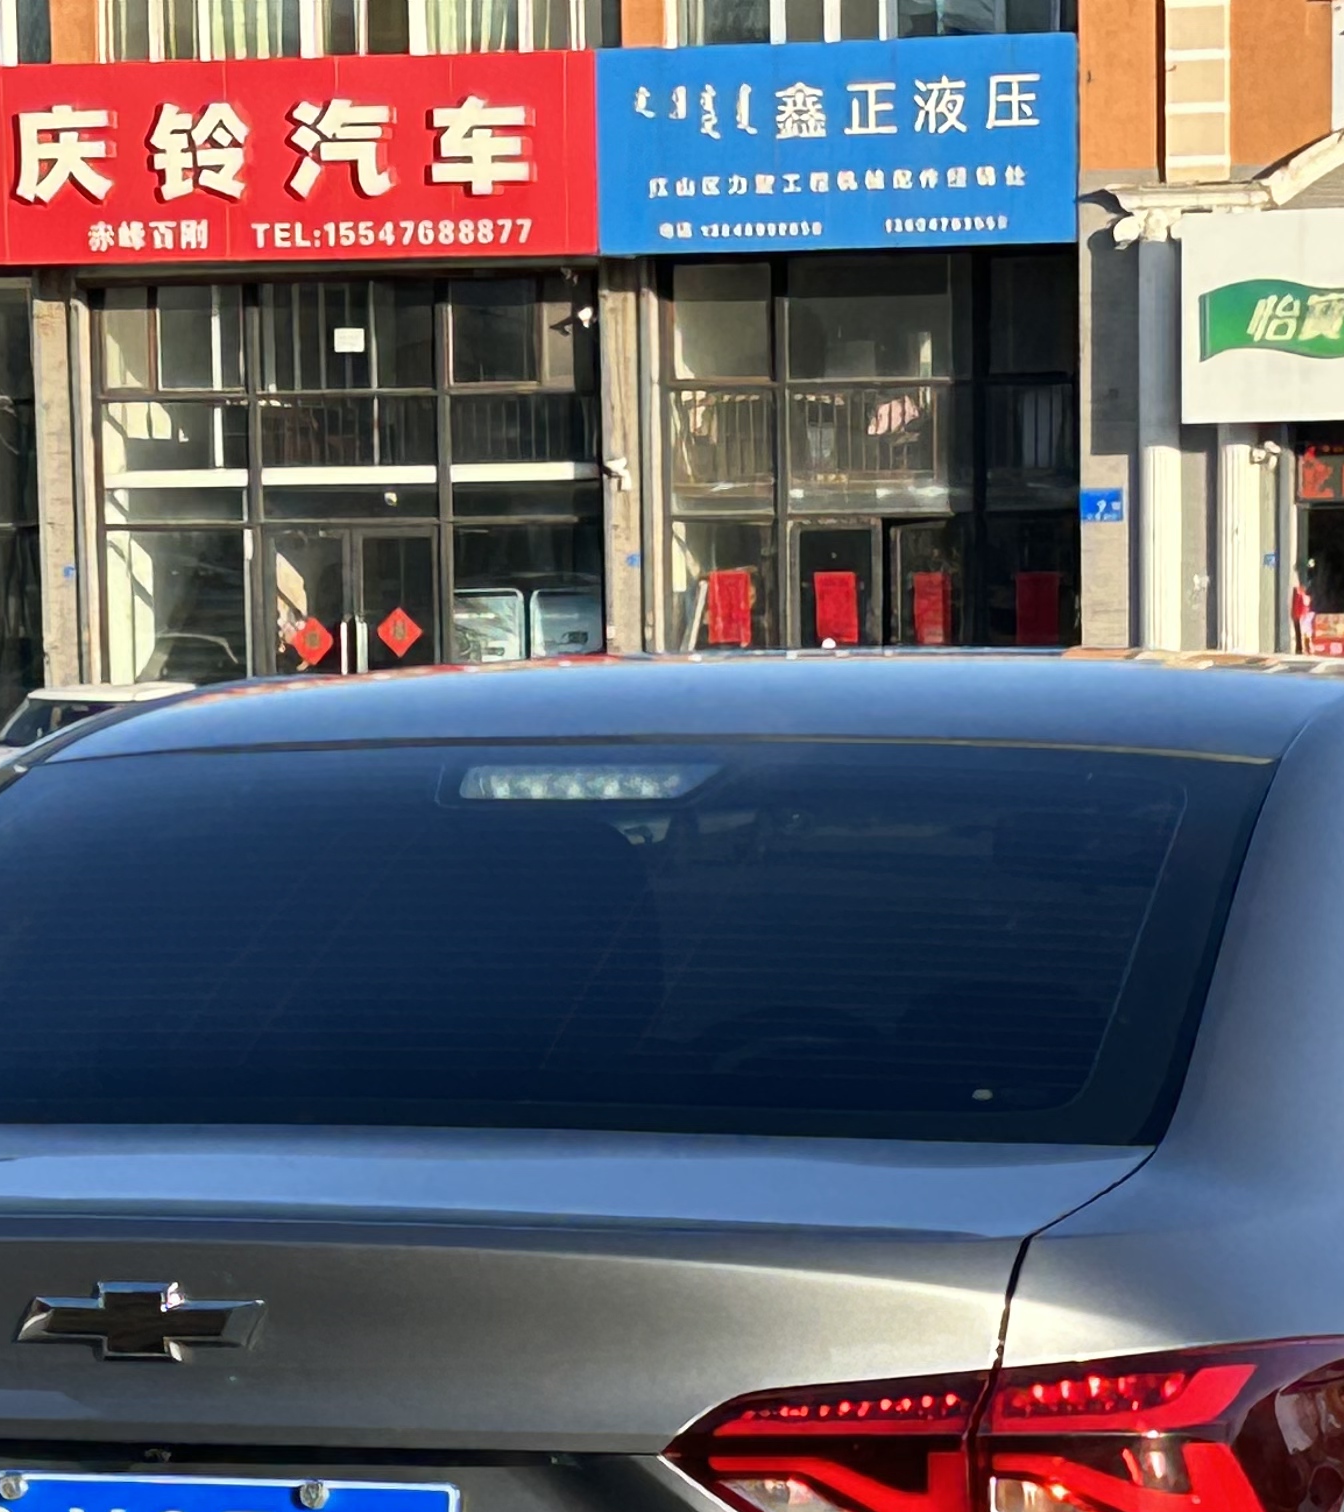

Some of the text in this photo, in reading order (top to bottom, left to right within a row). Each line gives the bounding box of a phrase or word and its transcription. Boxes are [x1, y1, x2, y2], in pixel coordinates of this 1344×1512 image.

[15, 96, 532, 202] 庆铃汽车
[775, 73, 1042, 139] 鑫正液压
